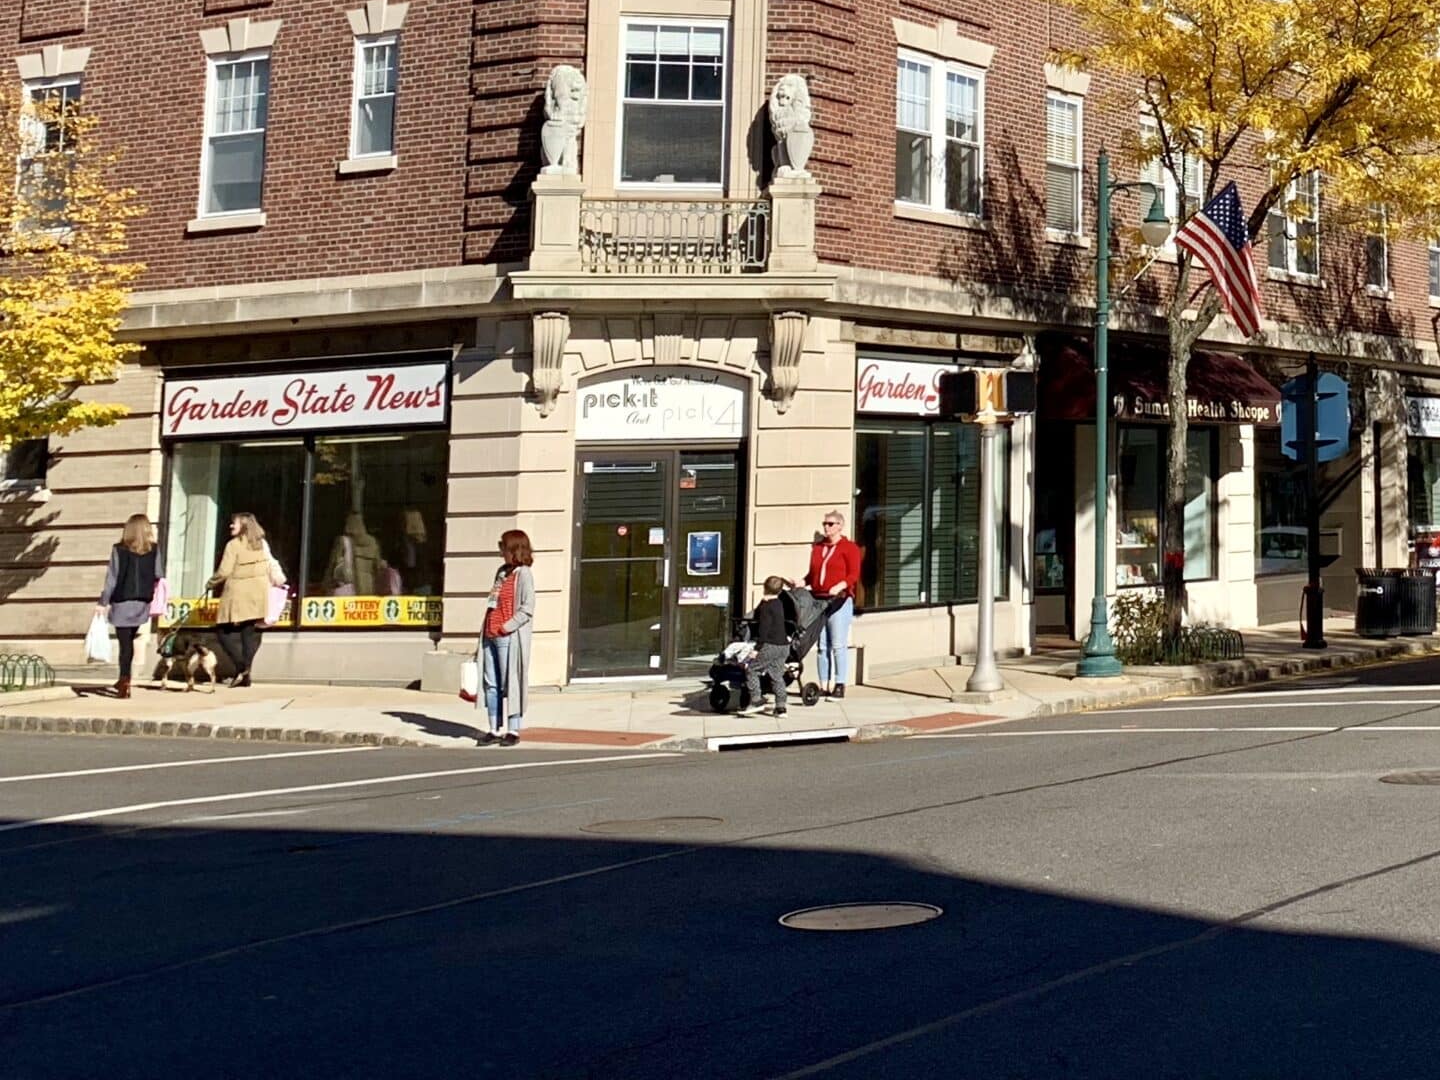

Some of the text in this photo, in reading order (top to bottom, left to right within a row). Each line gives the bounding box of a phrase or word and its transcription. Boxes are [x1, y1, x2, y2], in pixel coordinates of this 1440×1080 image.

[858, 364, 926, 408] Garden
[167, 373, 446, 432] Garden State News
[626, 394, 741, 433] And pick 4
[1187, 399, 1226, 418] Health
[1230, 400, 1270, 422] Shoppe
[343, 600, 380, 610] LOTTERY
[343, 611, 378, 621] TICKETS
